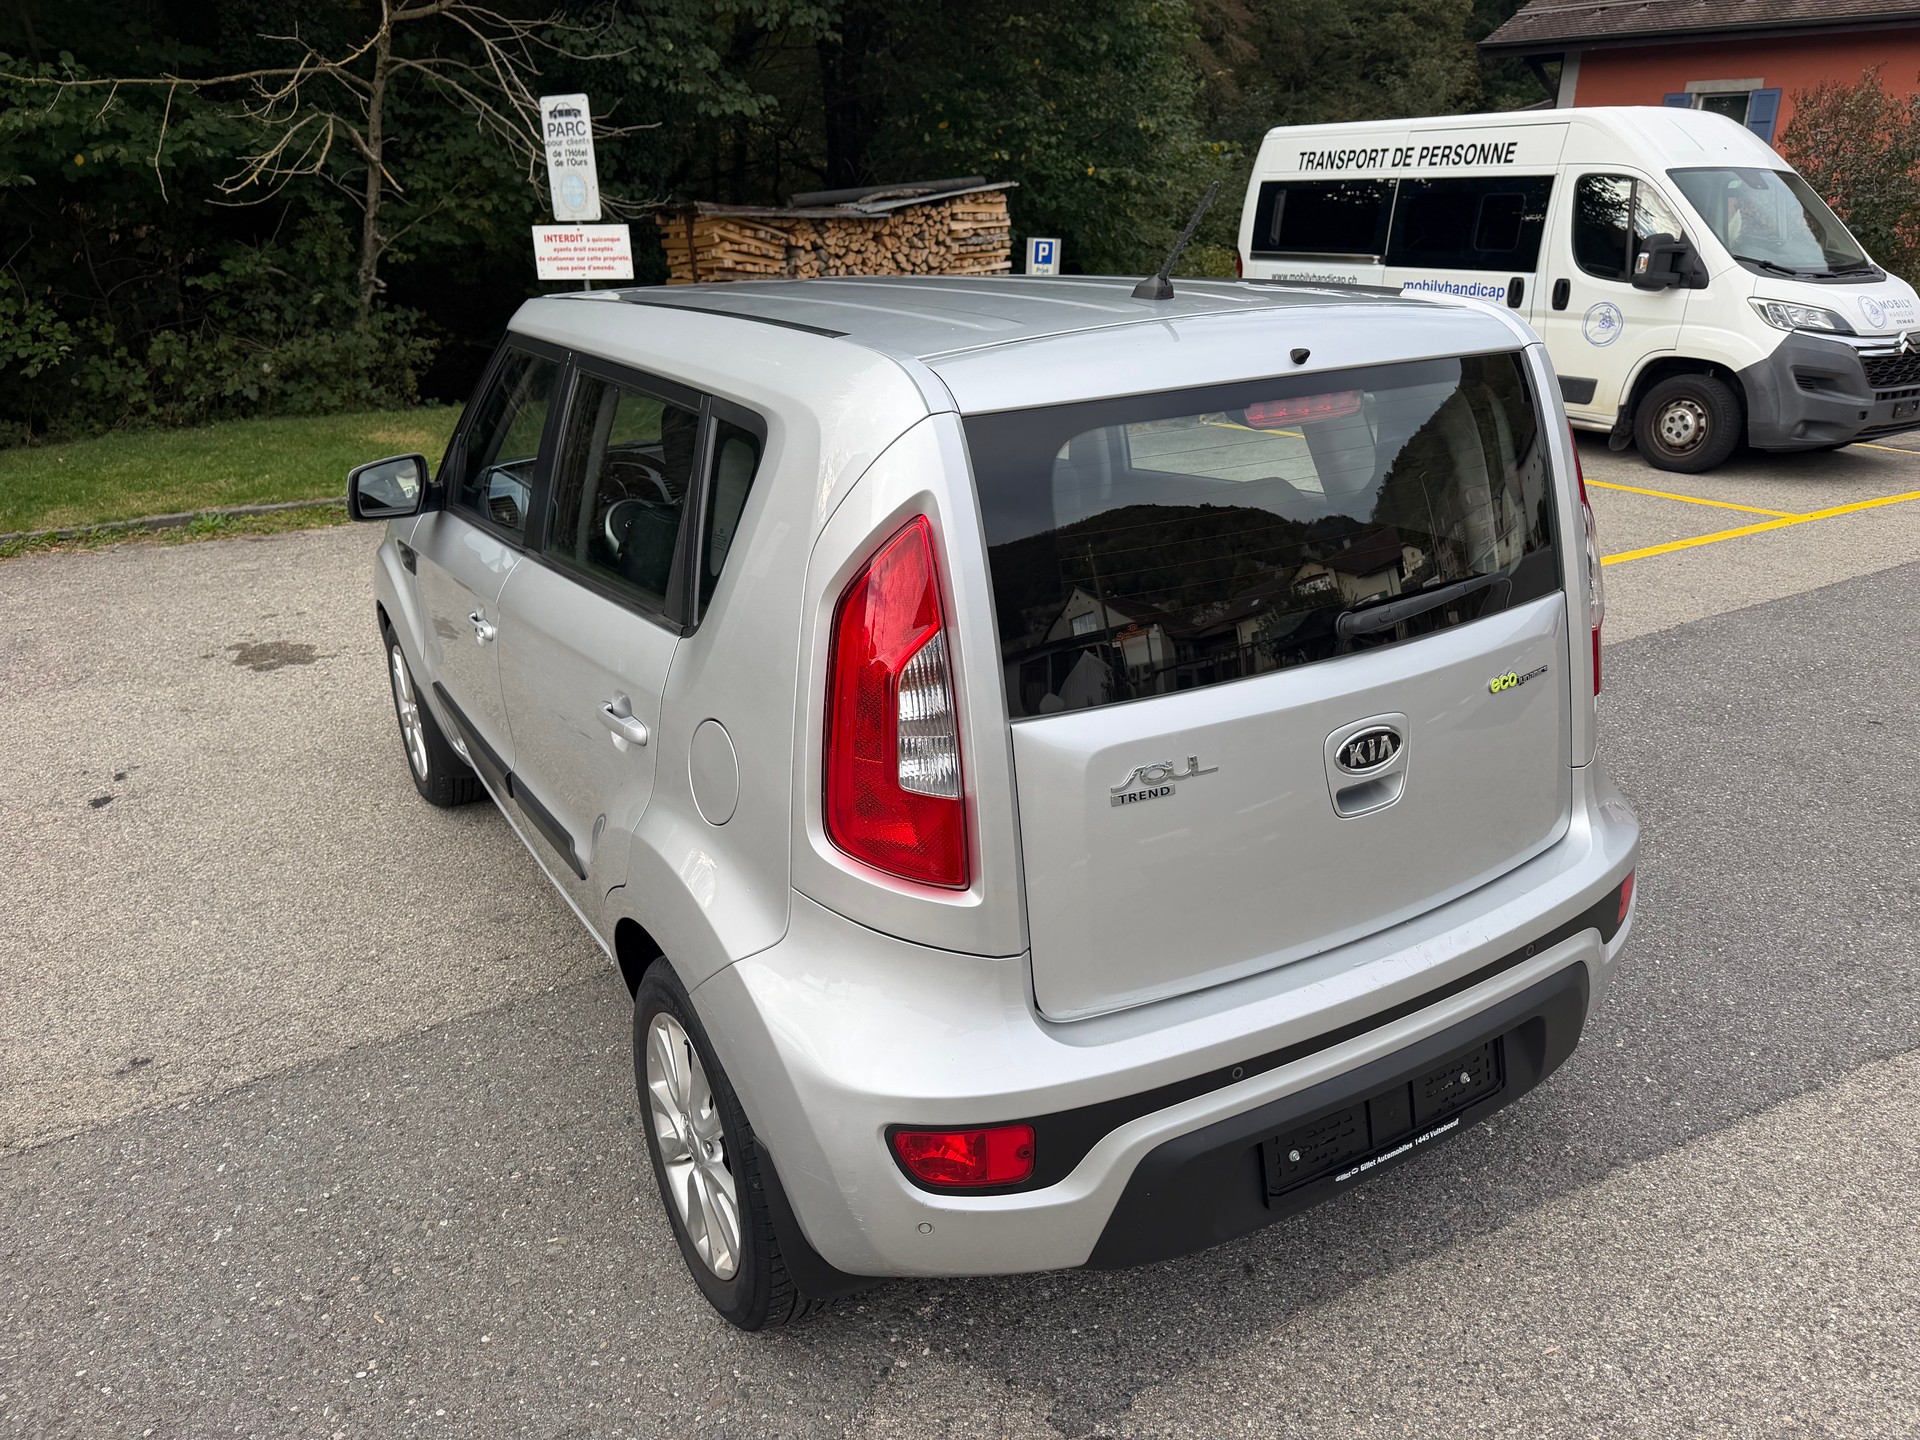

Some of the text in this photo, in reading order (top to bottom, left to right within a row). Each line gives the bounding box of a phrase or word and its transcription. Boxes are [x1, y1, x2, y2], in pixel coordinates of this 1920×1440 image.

[547, 121, 587, 137] PARC
[566, 137, 590, 146] clients
[552, 149, 562, 157] de
[554, 157, 588, 167] de l'Ours
[1298, 142, 1519, 170] TRANSPORT DE PERSONNE
[543, 233, 584, 243] INTERDIT
[1038, 243, 1049, 262] P
[1403, 280, 1505, 301] mobilyhandicap
[1878, 299, 1912, 309] MOBILY
[1348, 735, 1394, 767] KIA
[1110, 754, 1219, 794] SOUL
[1118, 786, 1171, 804] TREND
[1377, 1142, 1413, 1162] Automobiles
[1414, 1132, 1430, 1146] 1445
